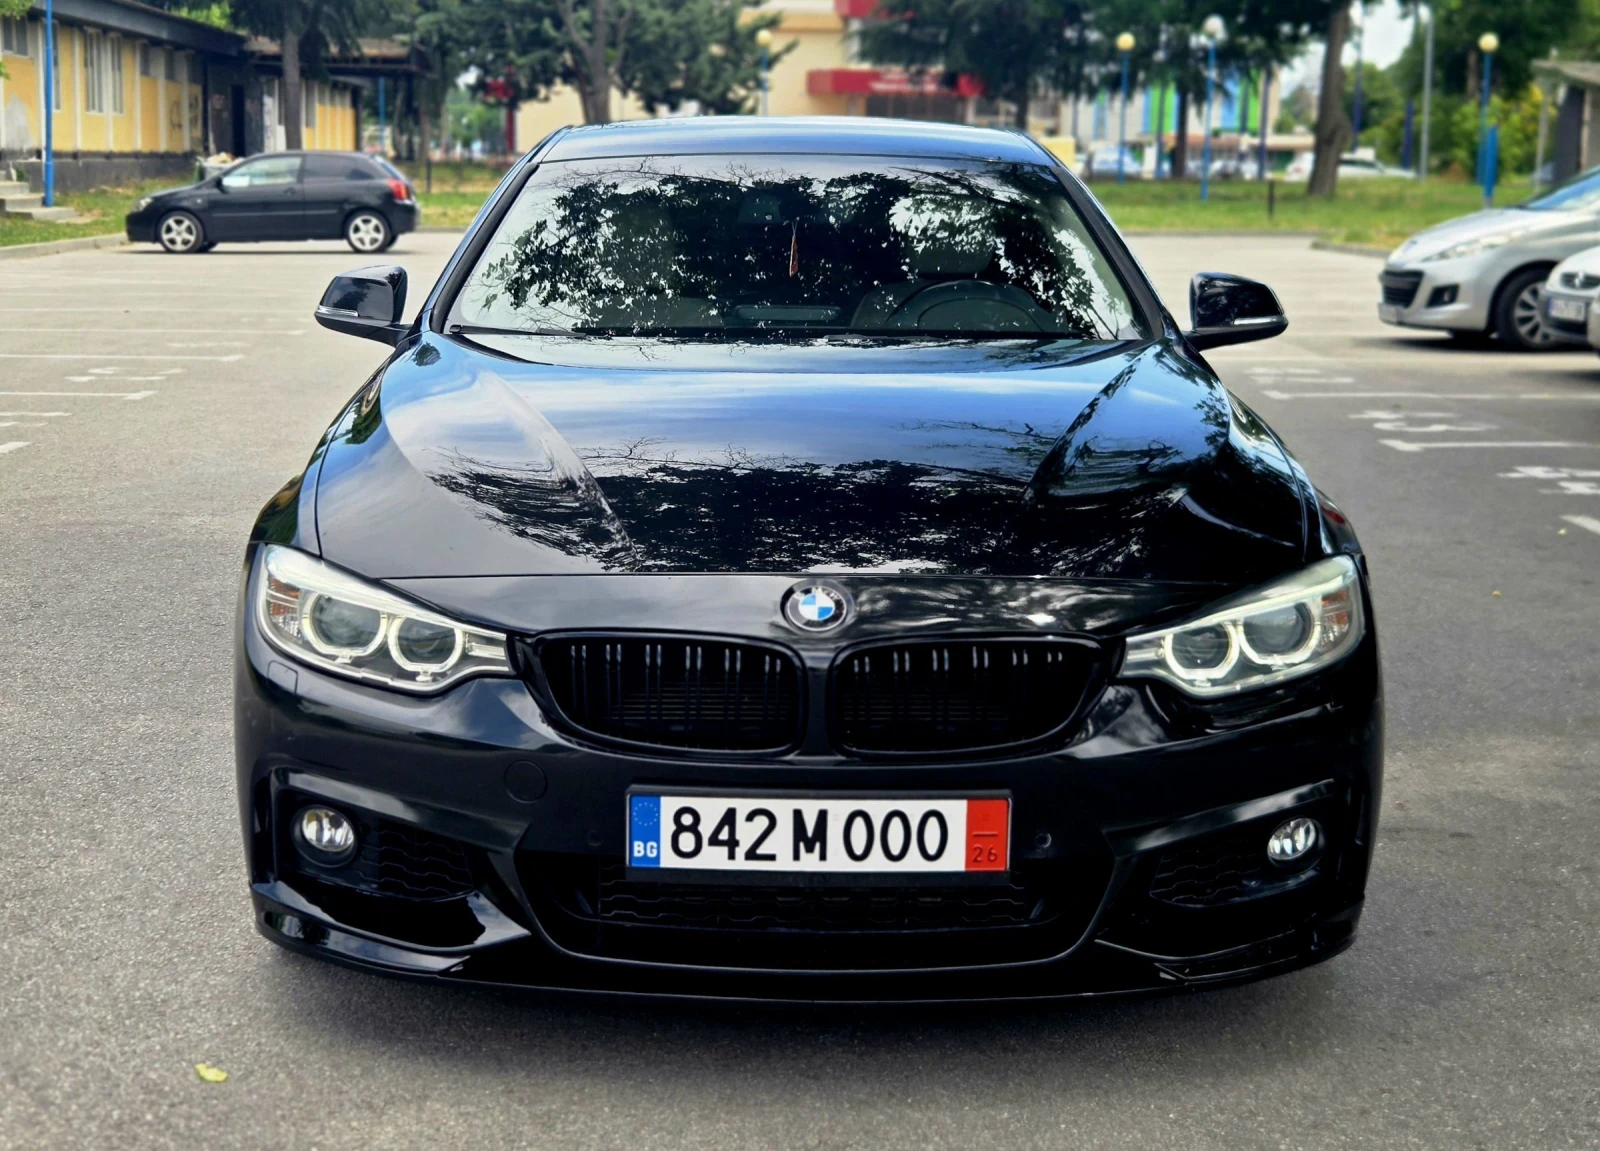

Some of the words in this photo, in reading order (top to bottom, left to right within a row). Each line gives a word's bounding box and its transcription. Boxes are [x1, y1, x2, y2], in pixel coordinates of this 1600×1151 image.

[670, 806, 777, 862] 842
[792, 808, 829, 862] M
[843, 809, 949, 862] 000
[633, 841, 658, 858] BG
[972, 844, 998, 863] 26
